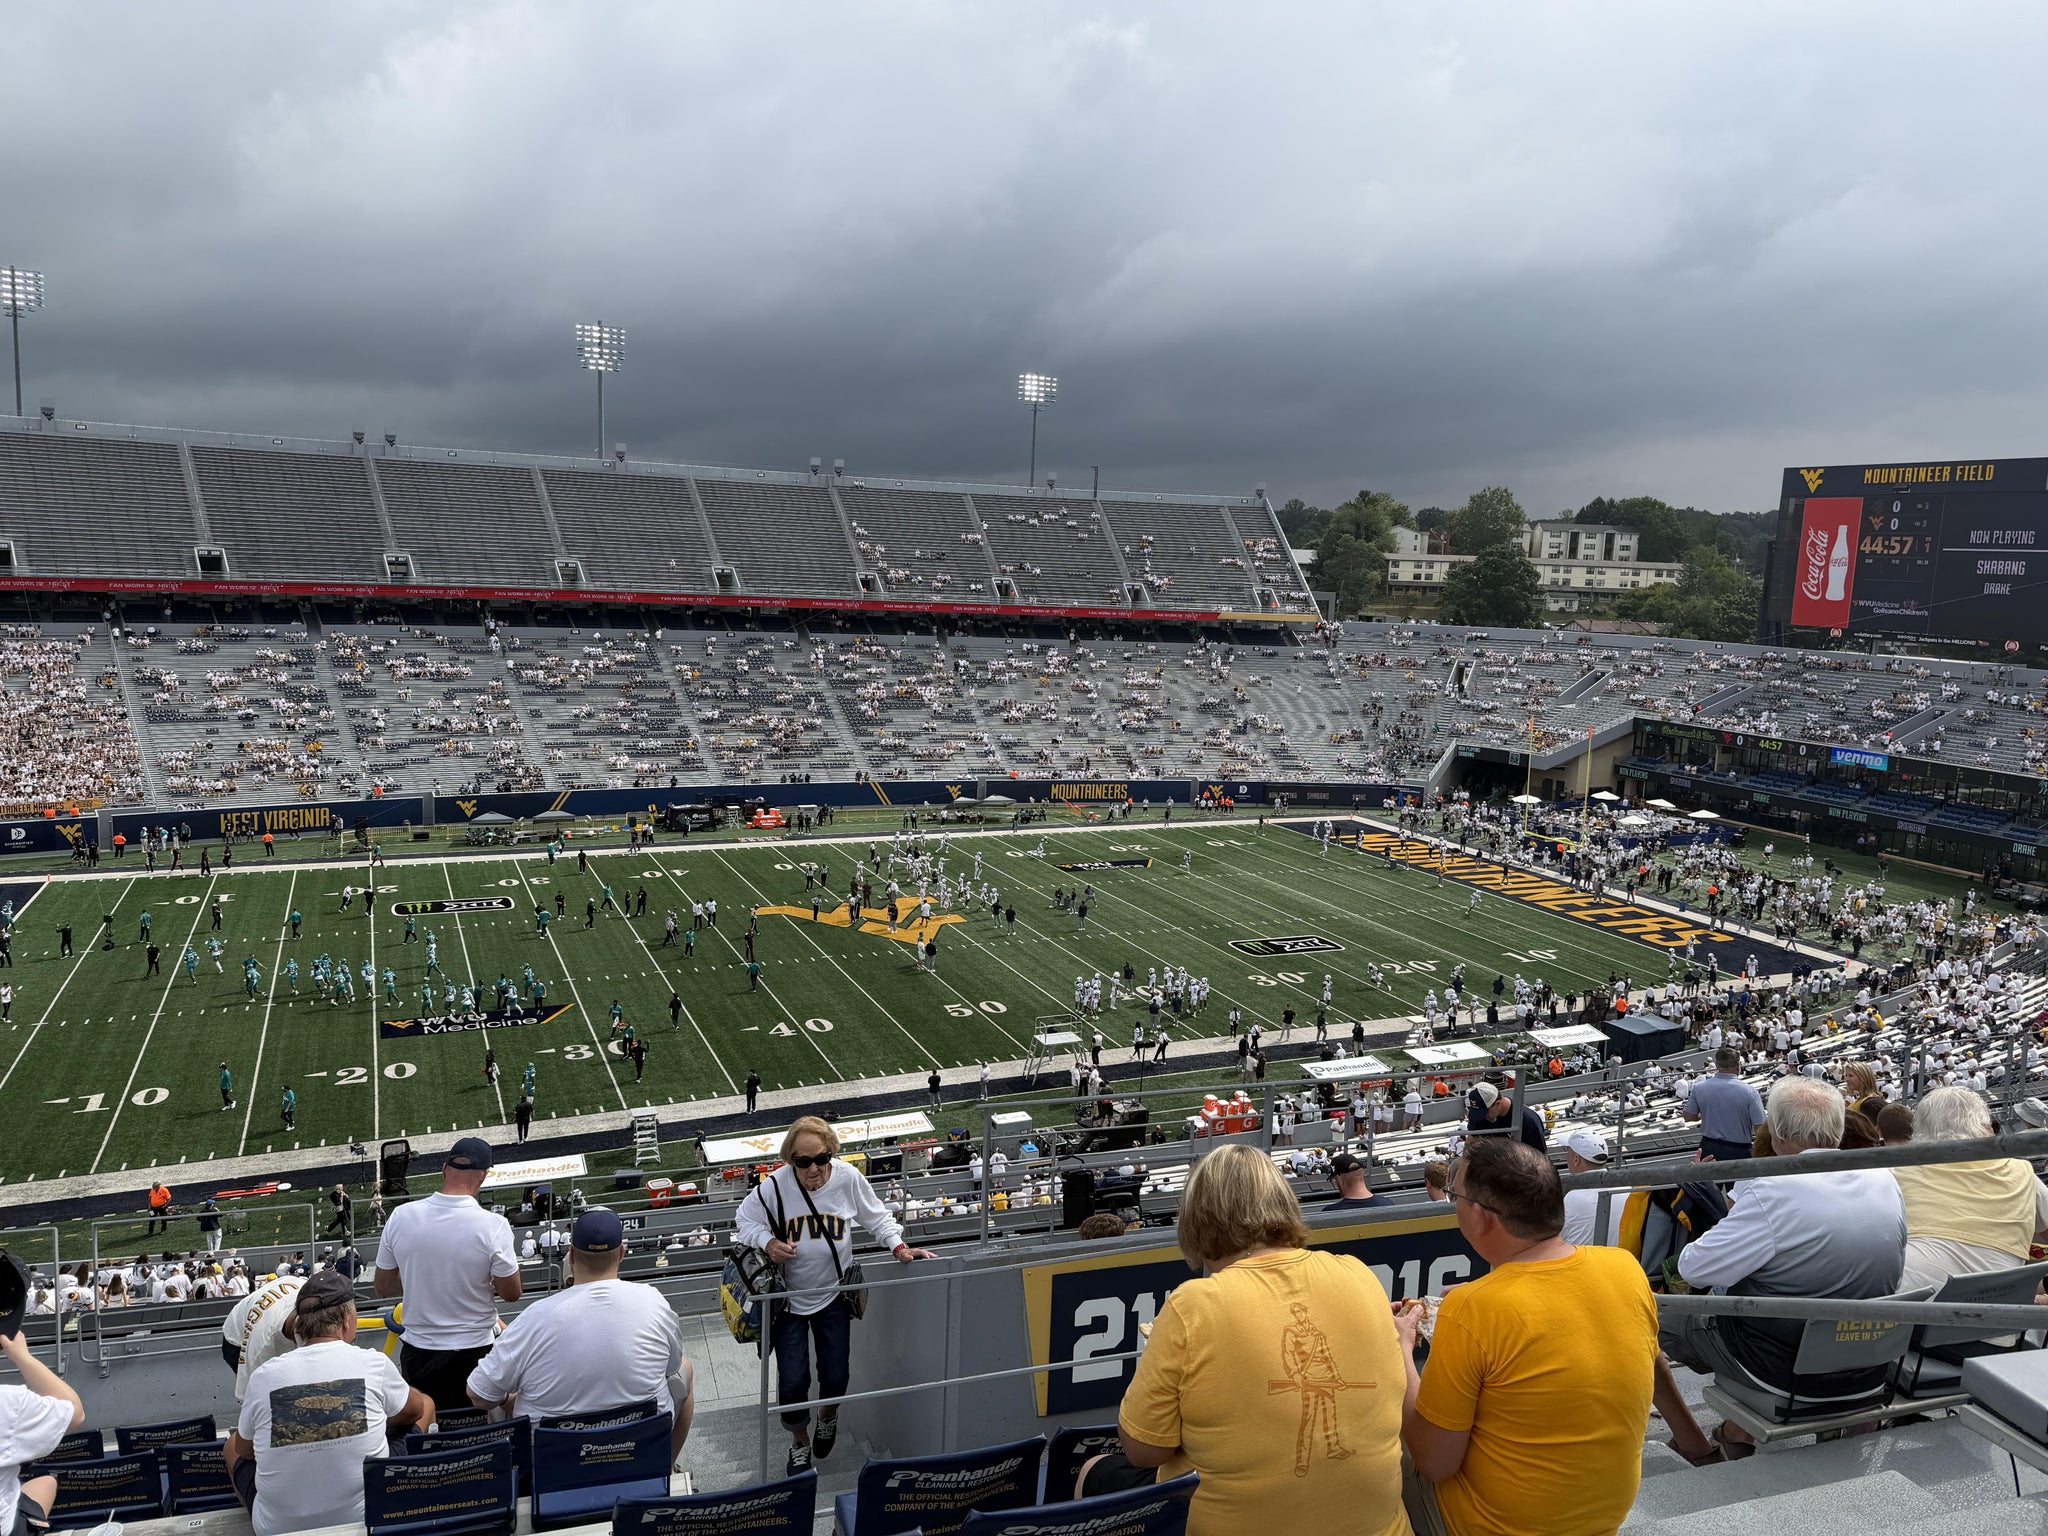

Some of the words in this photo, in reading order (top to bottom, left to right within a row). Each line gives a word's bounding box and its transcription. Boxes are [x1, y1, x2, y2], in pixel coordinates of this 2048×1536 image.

[1863, 465, 1950, 484] MOUNTAINEER
[1955, 464, 1994, 481] FIELD
[1893, 500, 1901, 512] 0
[1890, 518, 1898, 530] 0
[1860, 536, 1914, 555] 44:57
[1969, 530, 1990, 544] NOW
[1992, 530, 2036, 545] PLAYING
[1802, 525, 1829, 600] Coca-Cola
[1976, 560, 2026, 576] SHABANG
[1984, 582, 2012, 595] DRAKE
[1736, 735, 1744, 746] 0
[1758, 740, 1782, 750] 44:57
[1836, 750, 1883, 767] venmo
[1051, 784, 1128, 800] MOUNTAINEERS
[220, 812, 260, 834] WEST
[264, 807, 330, 830] VIRGINIA
[2013, 842, 2036, 856] DRAKE
[944, 1000, 1008, 1018] 50
[423, 1016, 538, 1035] Medicine
[768, 1018, 834, 1037] 40
[334, 1062, 418, 1086] 20
[1324, 1062, 1379, 1073] Panhandle
[72, 1088, 170, 1114] 10
[858, 1118, 924, 1135] Panhandle
[1215, 1120, 1224, 1133] G
[1243, 1118, 1253, 1129] G
[494, 1162, 580, 1179] Panhandle
[786, 1214, 846, 1242] WVU
[1835, 1331, 1861, 1342] LEAVE
[1861, 1331, 1871, 1340] IN
[574, 1410, 644, 1430] Panhandle
[144, 1425, 202, 1437] Panhandle
[442, 1428, 516, 1444] Panhandle
[592, 1441, 636, 1451] Panhandle
[68, 1463, 140, 1474] Panhandle
[408, 1454, 494, 1472] Panhandle
[918, 1456, 1023, 1482] Panhandle
[440, 1467, 484, 1482] RESTORATION
[967, 1466, 1018, 1488] RESTORATION
[386, 1484, 419, 1494] COMPANY
[954, 1479, 1006, 1500] RESTORATION
[383, 1496, 498, 1520] www.mountaineerseats.com
[676, 1491, 792, 1516] Panhandle
[730, 1498, 789, 1516] RESTORATION
[884, 1502, 926, 1512] COMPANY
[940, 1502, 955, 1510] THE
[675, 1523, 714, 1532] OFFICIAL
[716, 1508, 776, 1528] RESTORATION
[1036, 1500, 1169, 1536] Panhandle
[1096, 1506, 1162, 1535] RESTORATION
